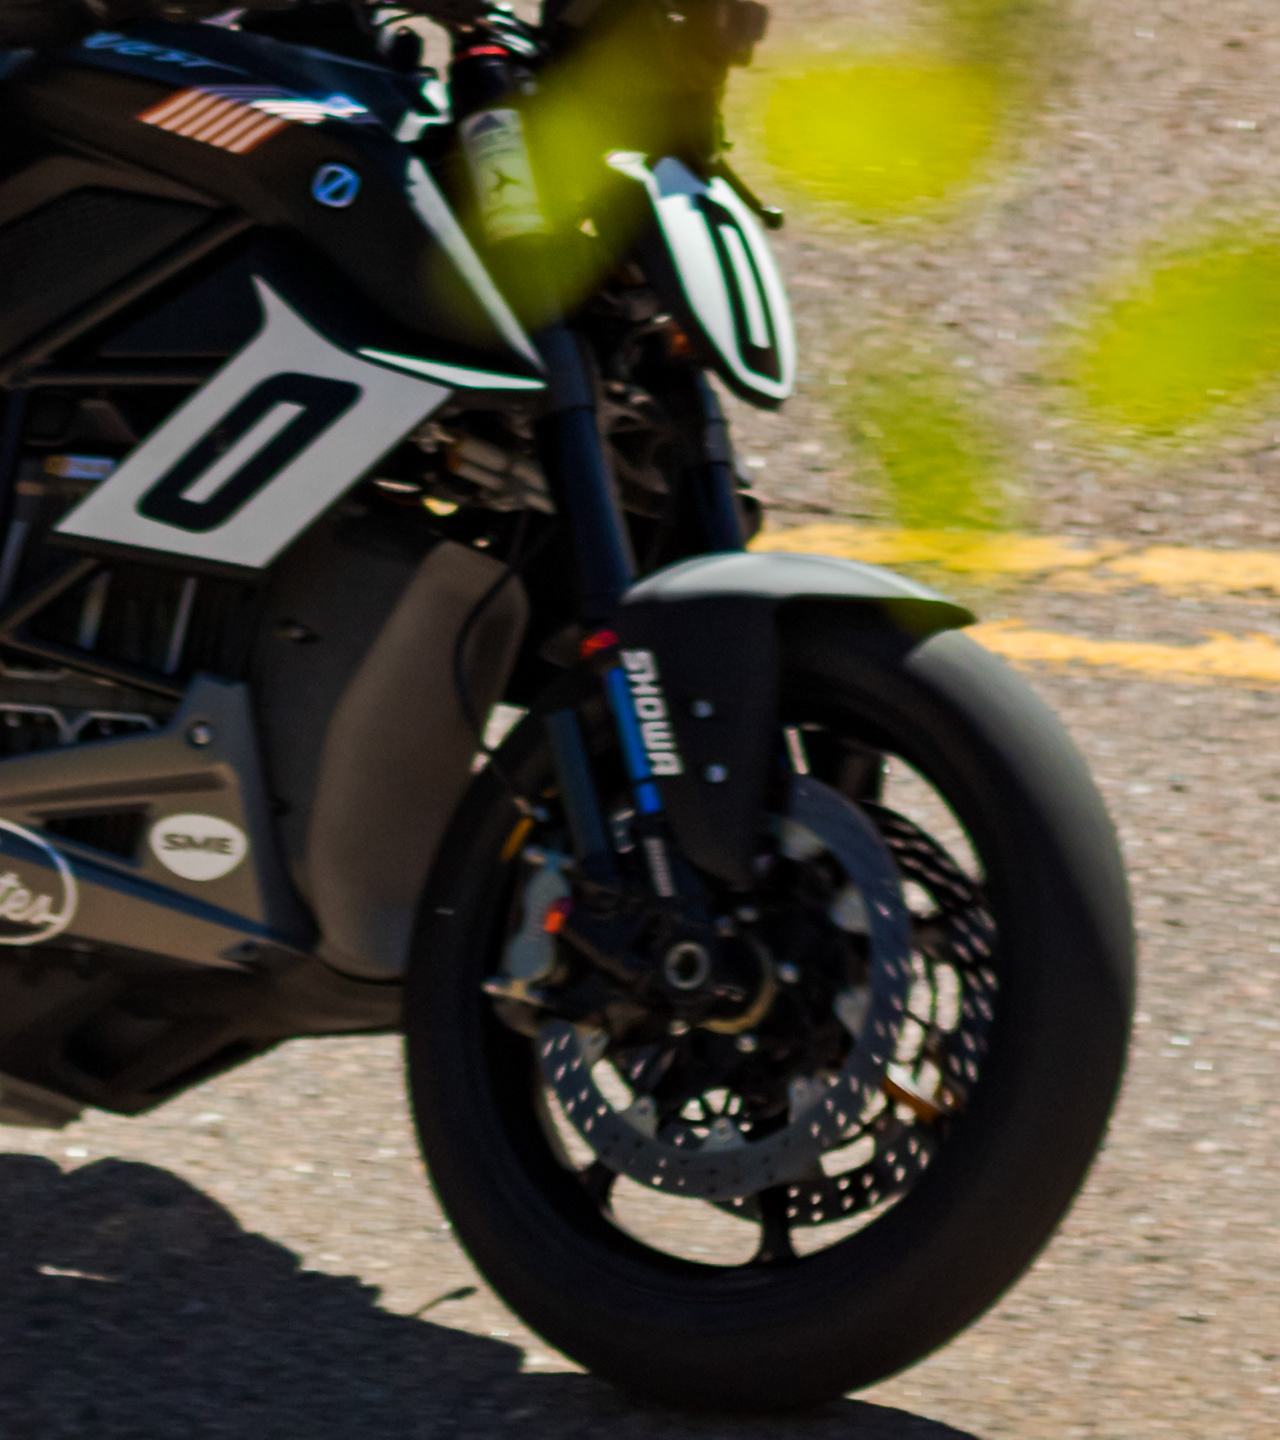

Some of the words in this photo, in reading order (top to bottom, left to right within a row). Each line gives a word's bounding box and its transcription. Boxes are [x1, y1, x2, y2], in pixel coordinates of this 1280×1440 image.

[134, 371, 364, 535] 0
[620, 648, 685, 776] SHOWA
[162, 832, 234, 857] SME
